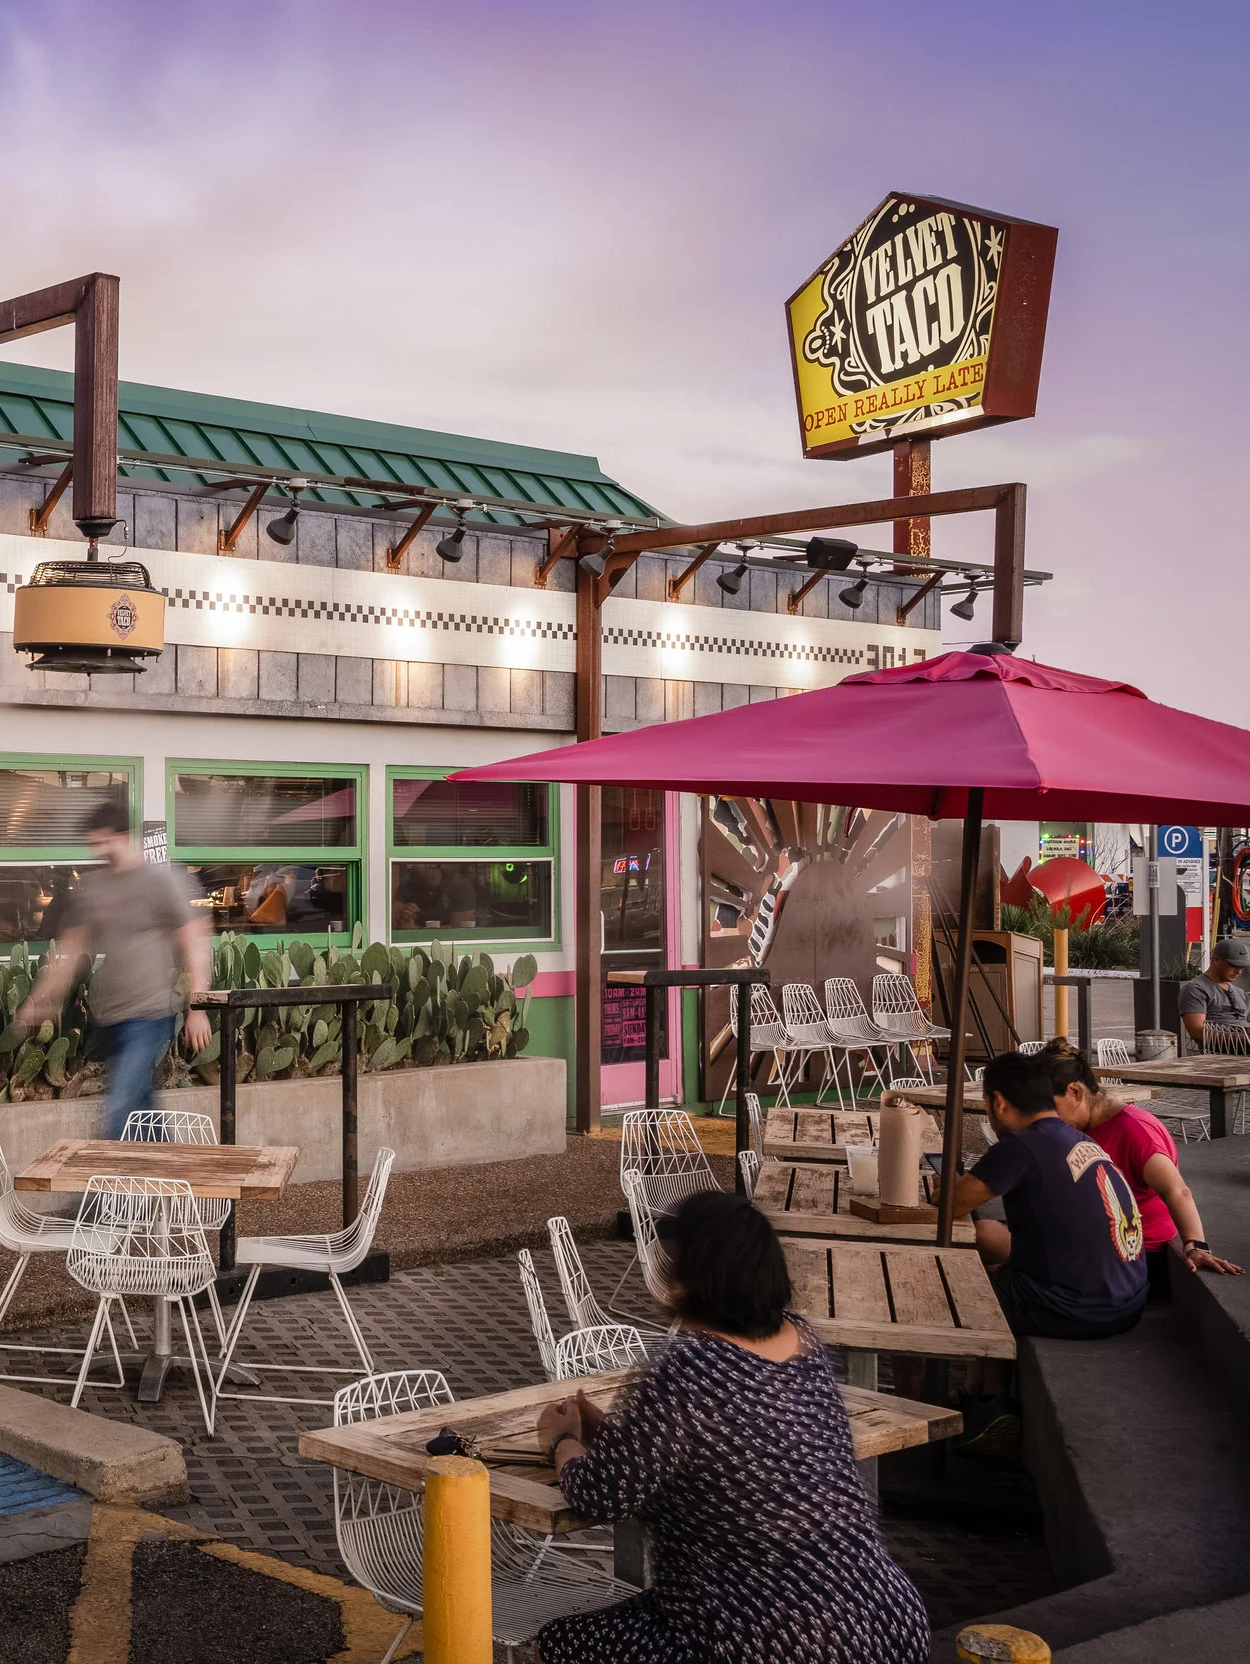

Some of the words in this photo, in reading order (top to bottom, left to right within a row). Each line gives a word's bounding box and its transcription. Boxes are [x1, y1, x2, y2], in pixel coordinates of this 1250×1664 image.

[862, 212, 958, 304] VELVET
[866, 263, 965, 375] TACO
[804, 402, 850, 432] OPEN
[854, 378, 927, 418] REALLY
[932, 364, 984, 396] LATE
[143, 833, 167, 849] SMOKE
[143, 846, 168, 864] FREE
[1172, 833, 1182, 848] P
